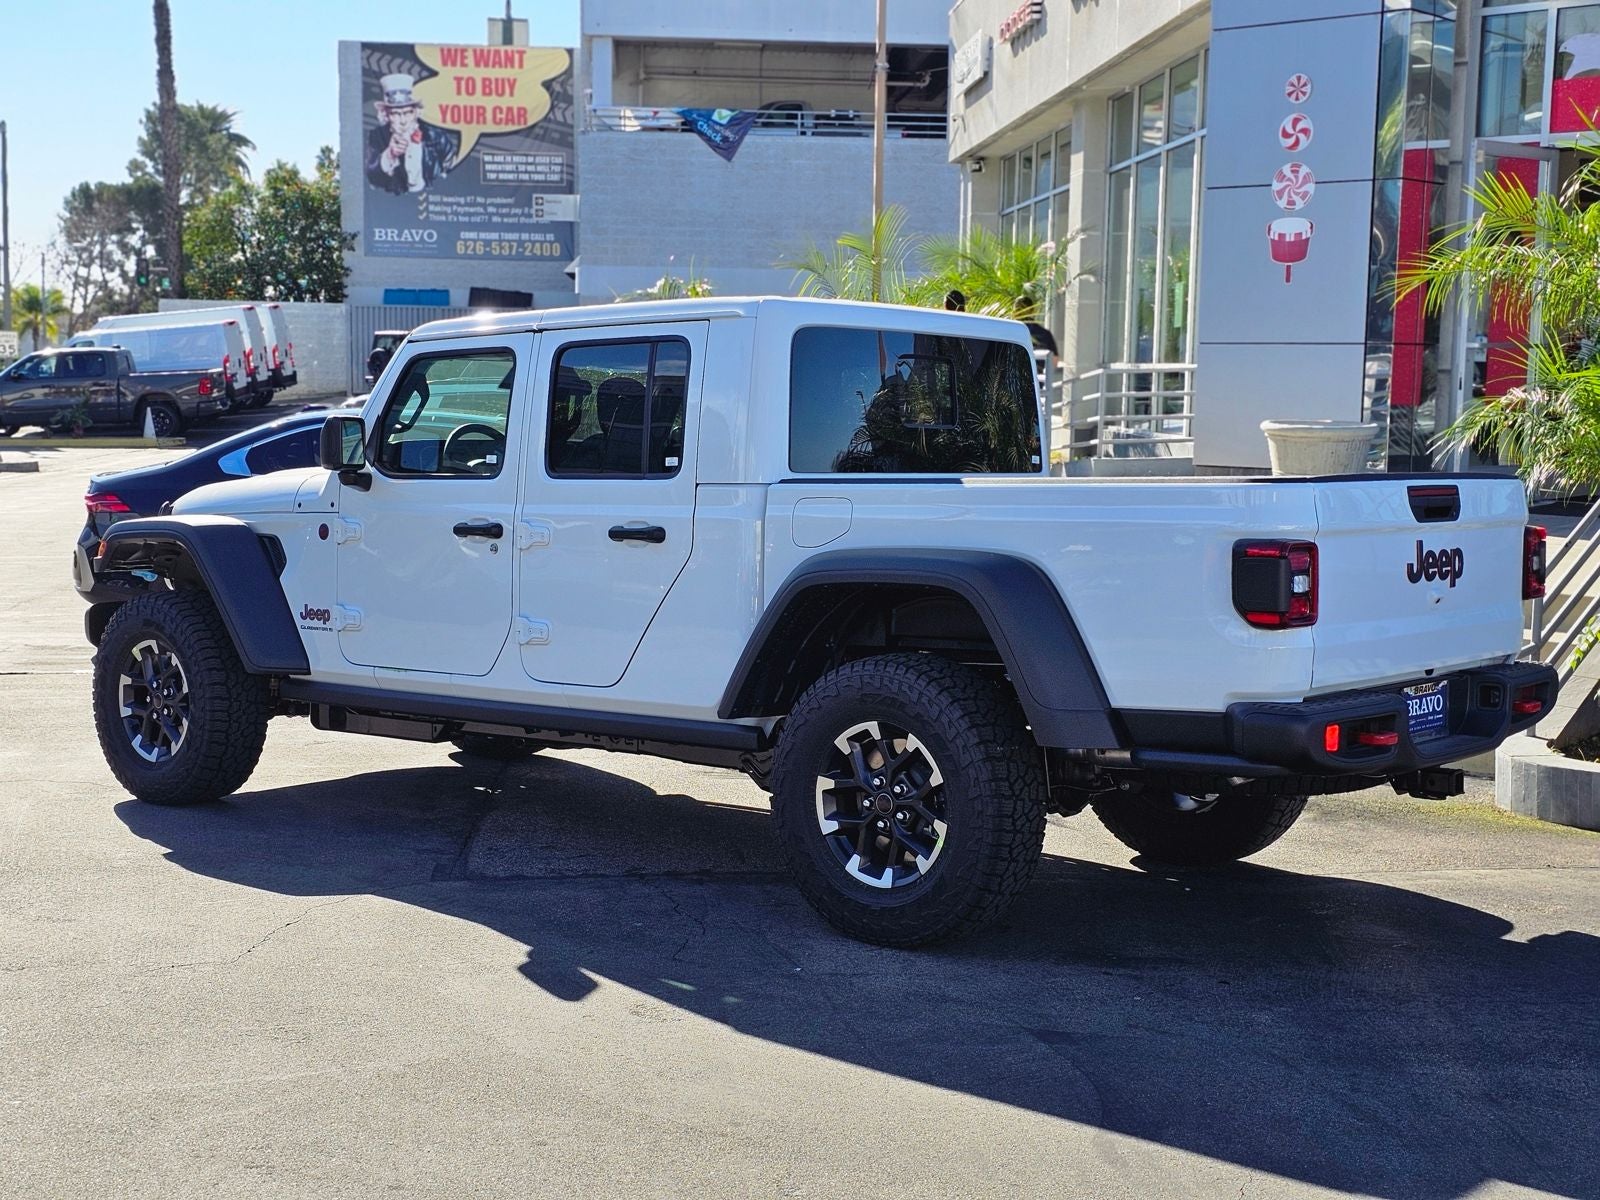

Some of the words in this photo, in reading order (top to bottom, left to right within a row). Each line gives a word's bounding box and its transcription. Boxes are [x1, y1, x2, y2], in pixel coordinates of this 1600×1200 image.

[440, 47, 468, 68] WE
[472, 48, 527, 69] WANT
[453, 76, 477, 97] TO
[481, 77, 517, 97] BUY
[438, 104, 487, 125] YOUR
[492, 106, 528, 126] CAR
[373, 228, 438, 242] BRAVO
[456, 240, 561, 257] 626-537-2400
[1406, 540, 1464, 588] Jeep
[300, 603, 331, 625] Jeep
